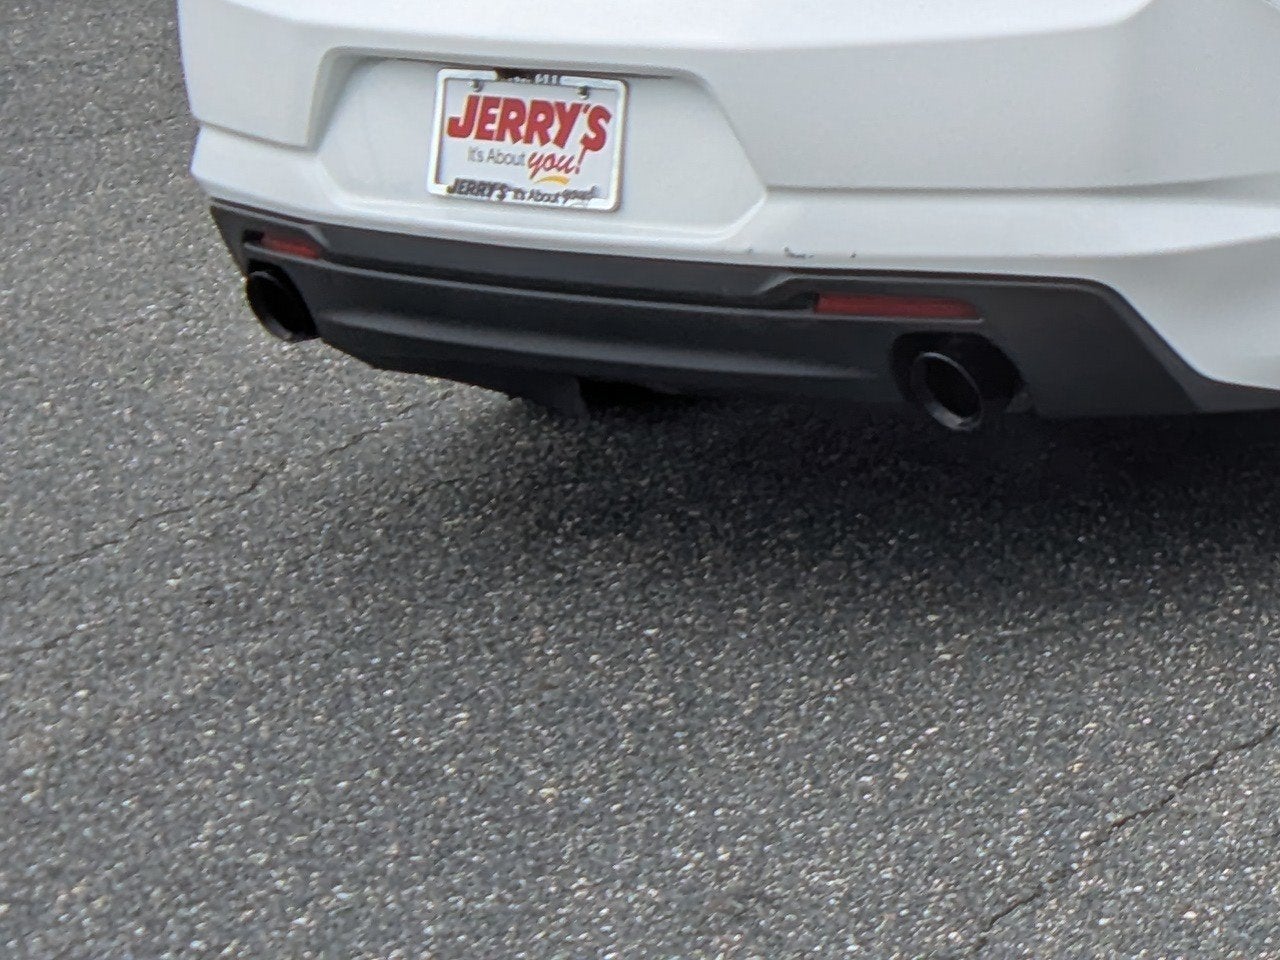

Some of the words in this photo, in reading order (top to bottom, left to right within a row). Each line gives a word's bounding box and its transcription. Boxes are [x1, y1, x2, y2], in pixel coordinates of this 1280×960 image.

[447, 94, 613, 152] JERRY'S
[467, 146, 484, 163] It's
[486, 148, 526, 167] About
[527, 144, 587, 180] you!
